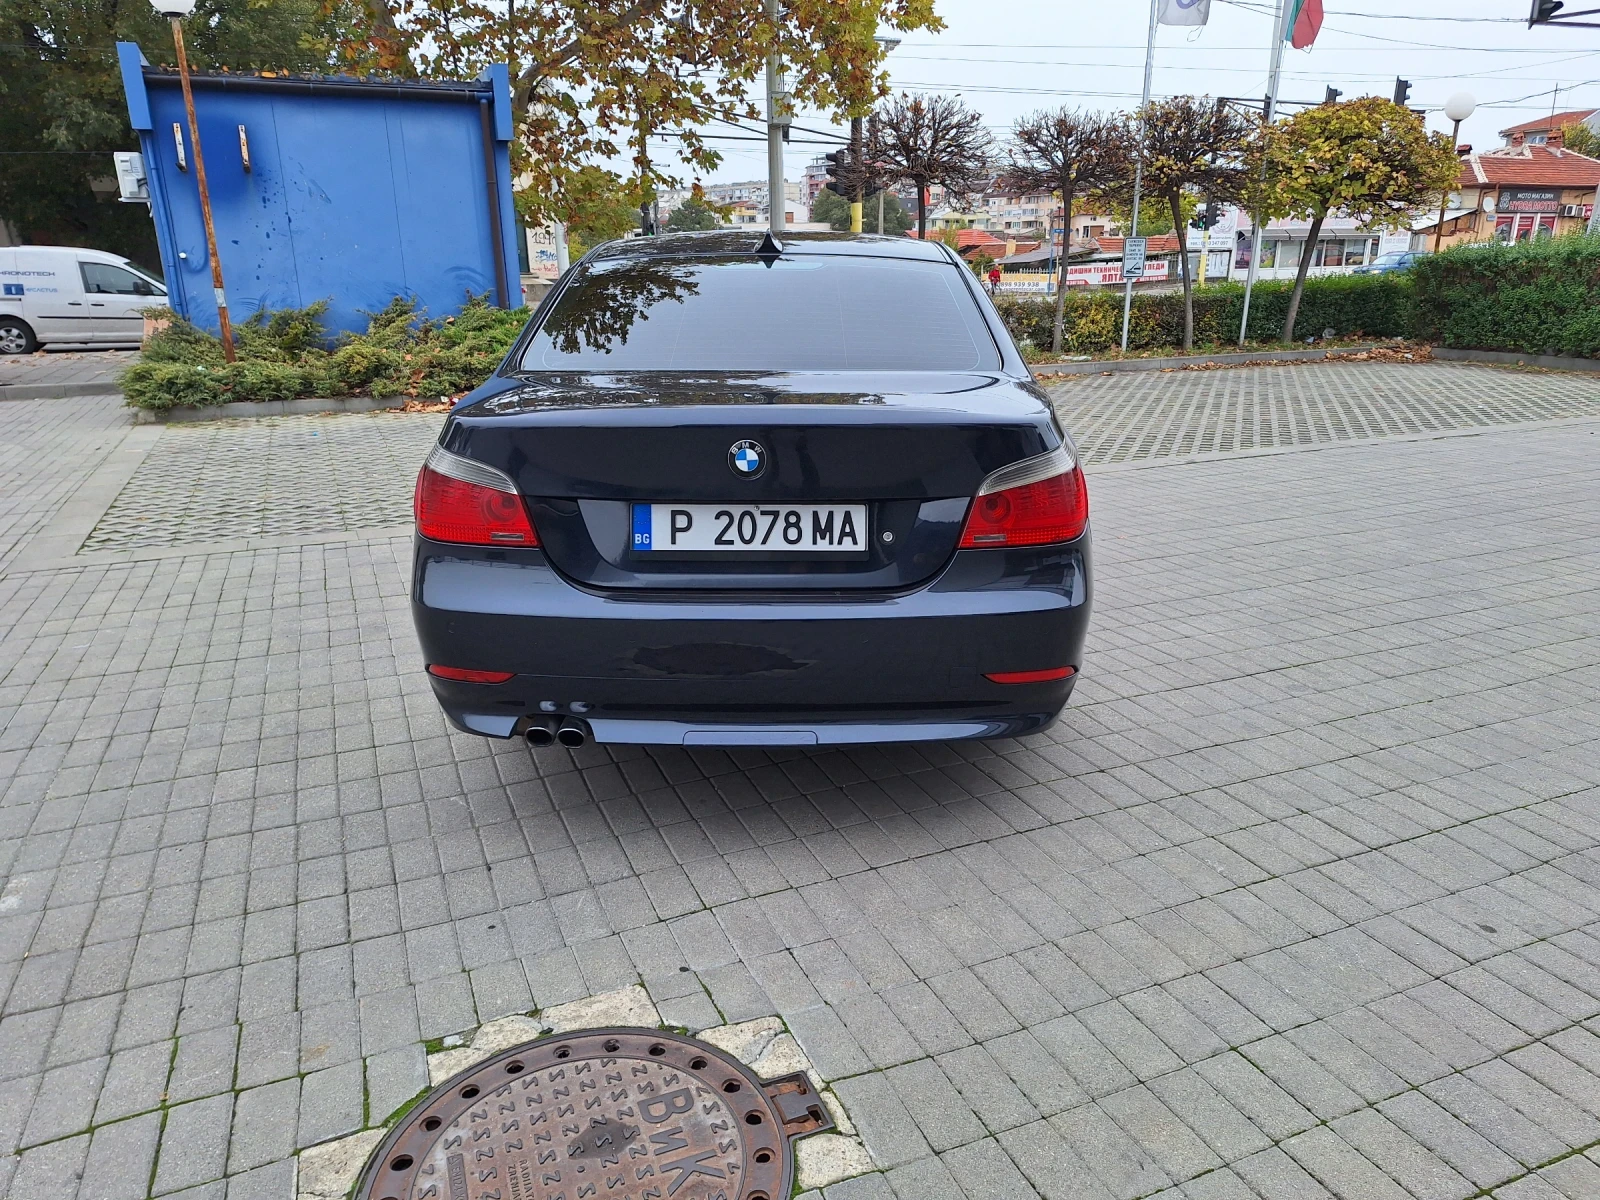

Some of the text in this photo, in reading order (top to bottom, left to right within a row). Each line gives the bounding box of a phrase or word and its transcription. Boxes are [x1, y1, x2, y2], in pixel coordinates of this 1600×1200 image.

[1093, 265, 1123, 274] ТЕХНИЧЕС
[1144, 263, 1164, 271] ГЛЕДИ
[731, 441, 762, 455] BMW
[670, 510, 858, 546] P 2078 MA
[634, 533, 650, 544] BG
